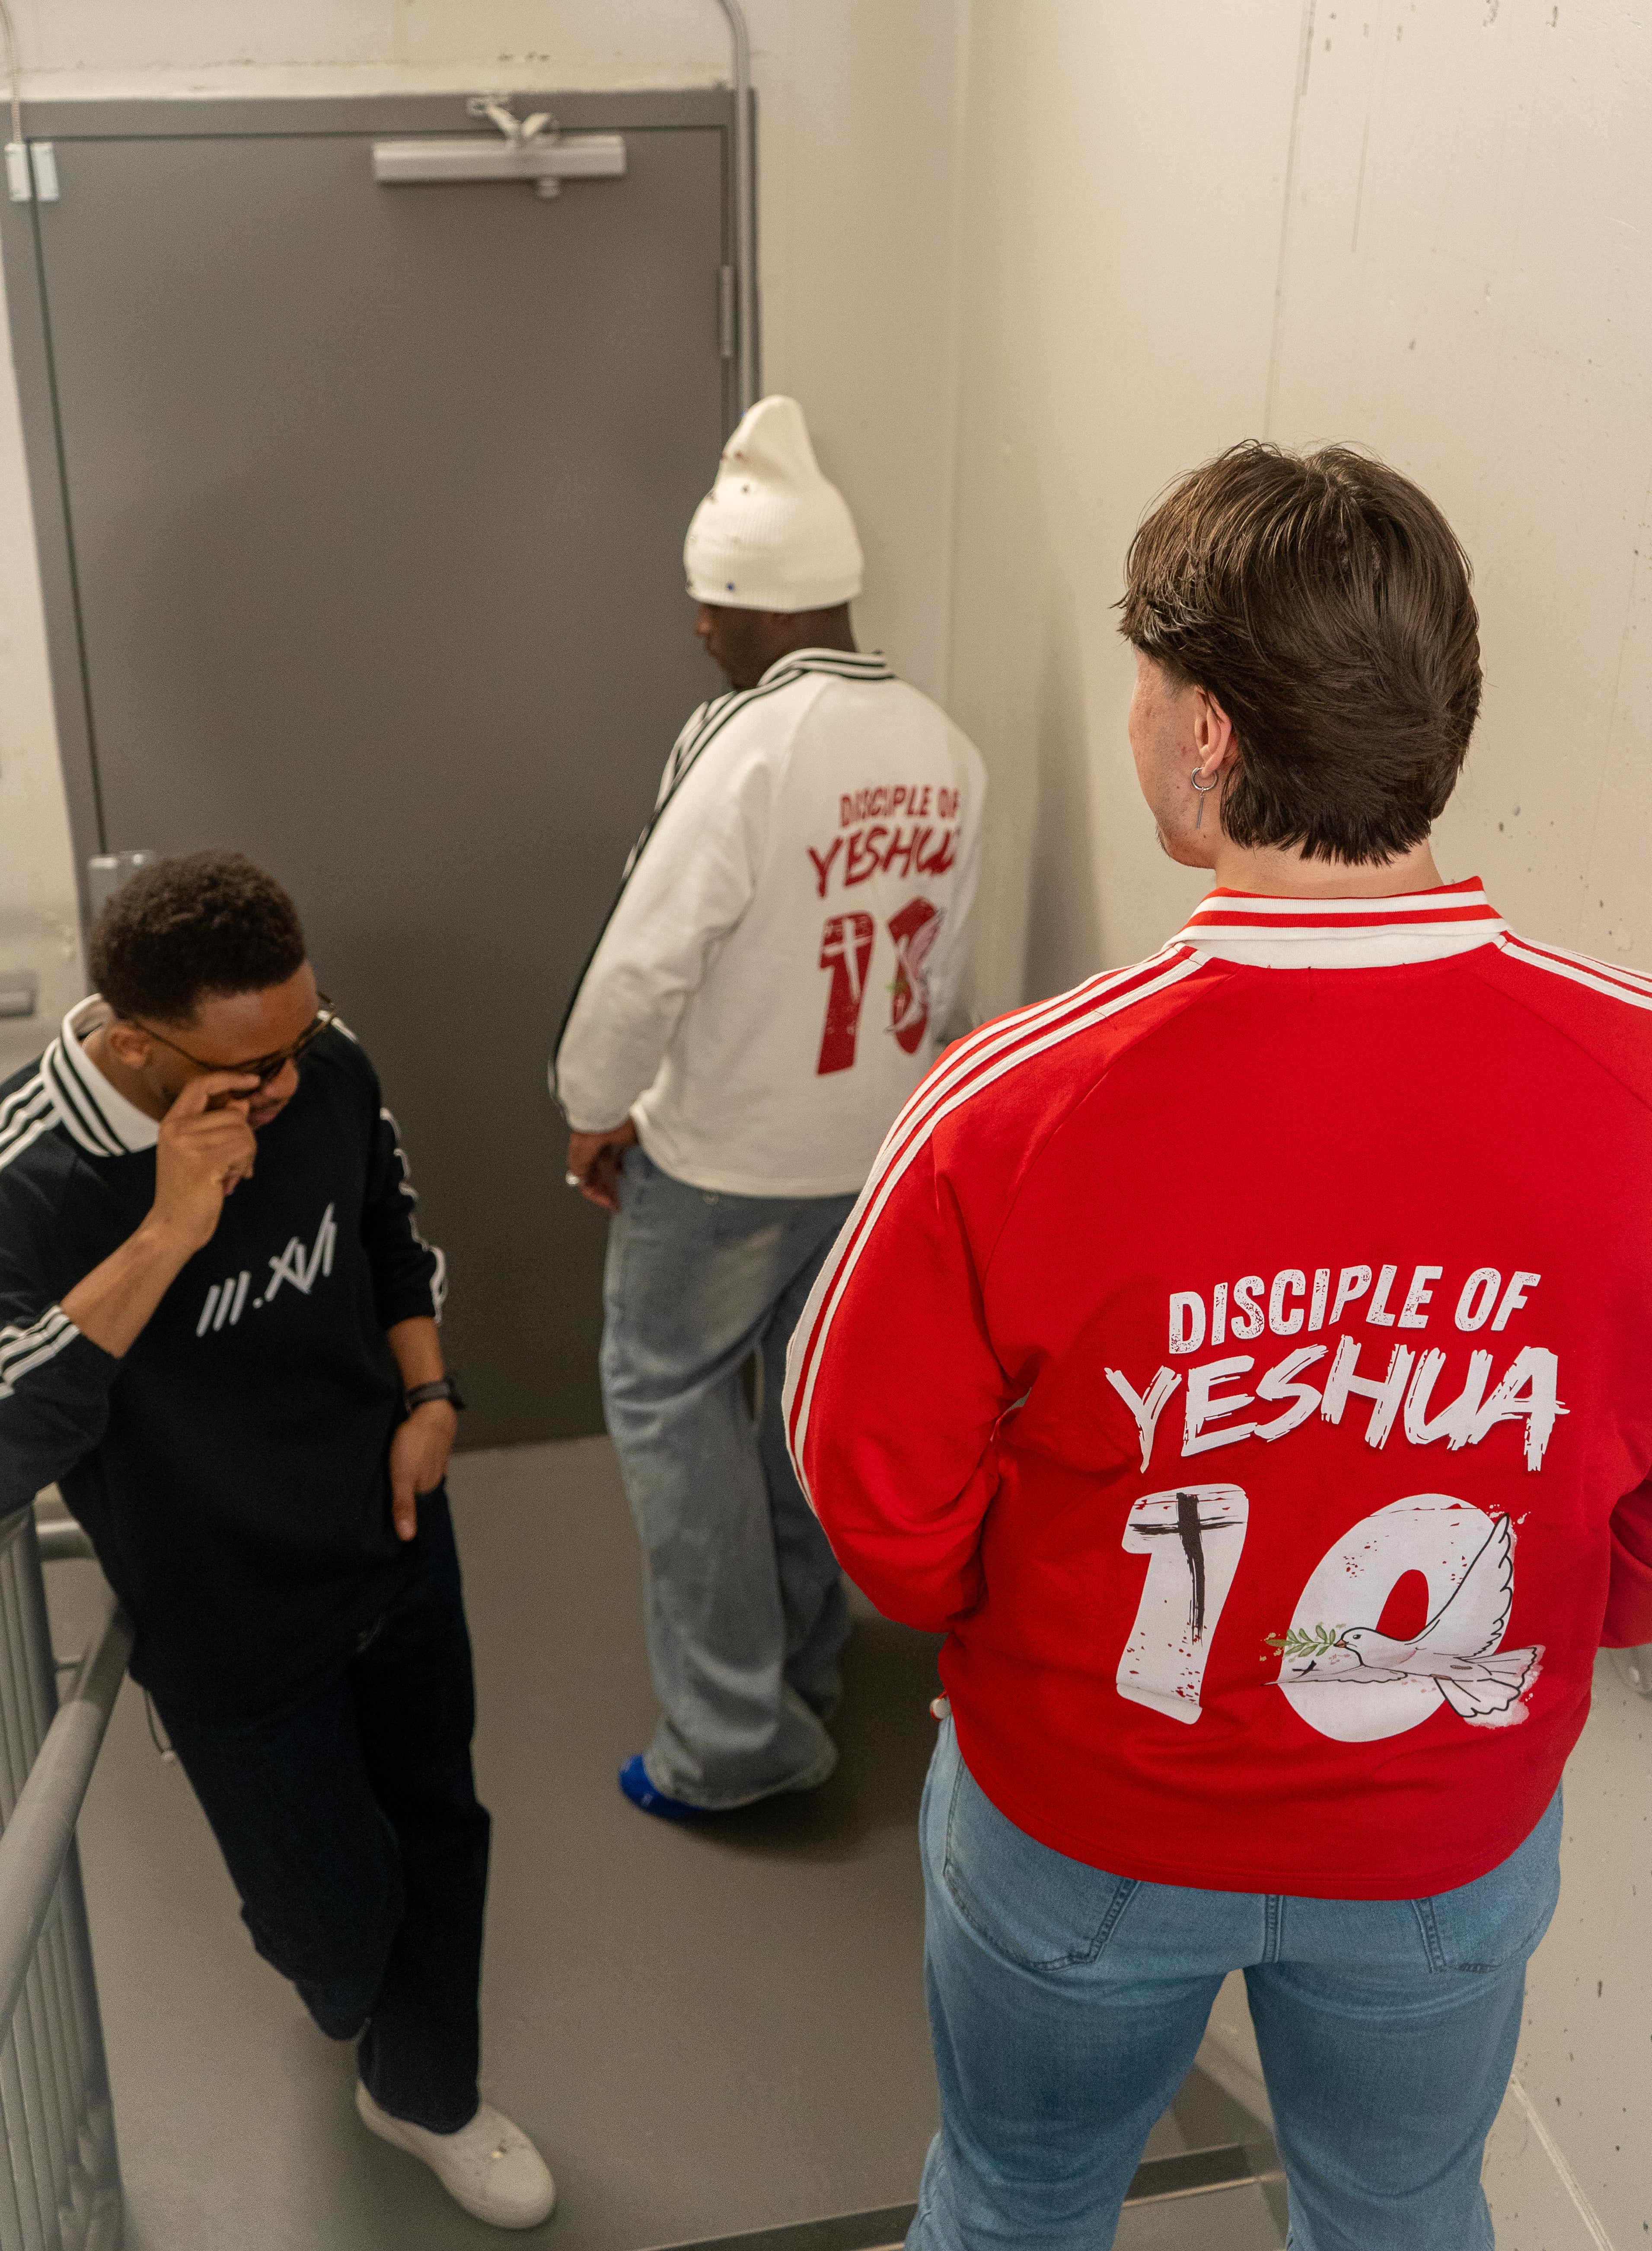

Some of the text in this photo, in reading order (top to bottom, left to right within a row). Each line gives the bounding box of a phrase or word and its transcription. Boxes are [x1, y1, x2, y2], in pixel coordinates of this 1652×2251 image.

[840, 785, 930, 825] DISCIPLE
[807, 825, 958, 898] YESHU
[1169, 1265, 1540, 1353] DISCIPLE OF
[1104, 1334, 1570, 1473] YESHUA
[1116, 1483, 1516, 1743] 10
